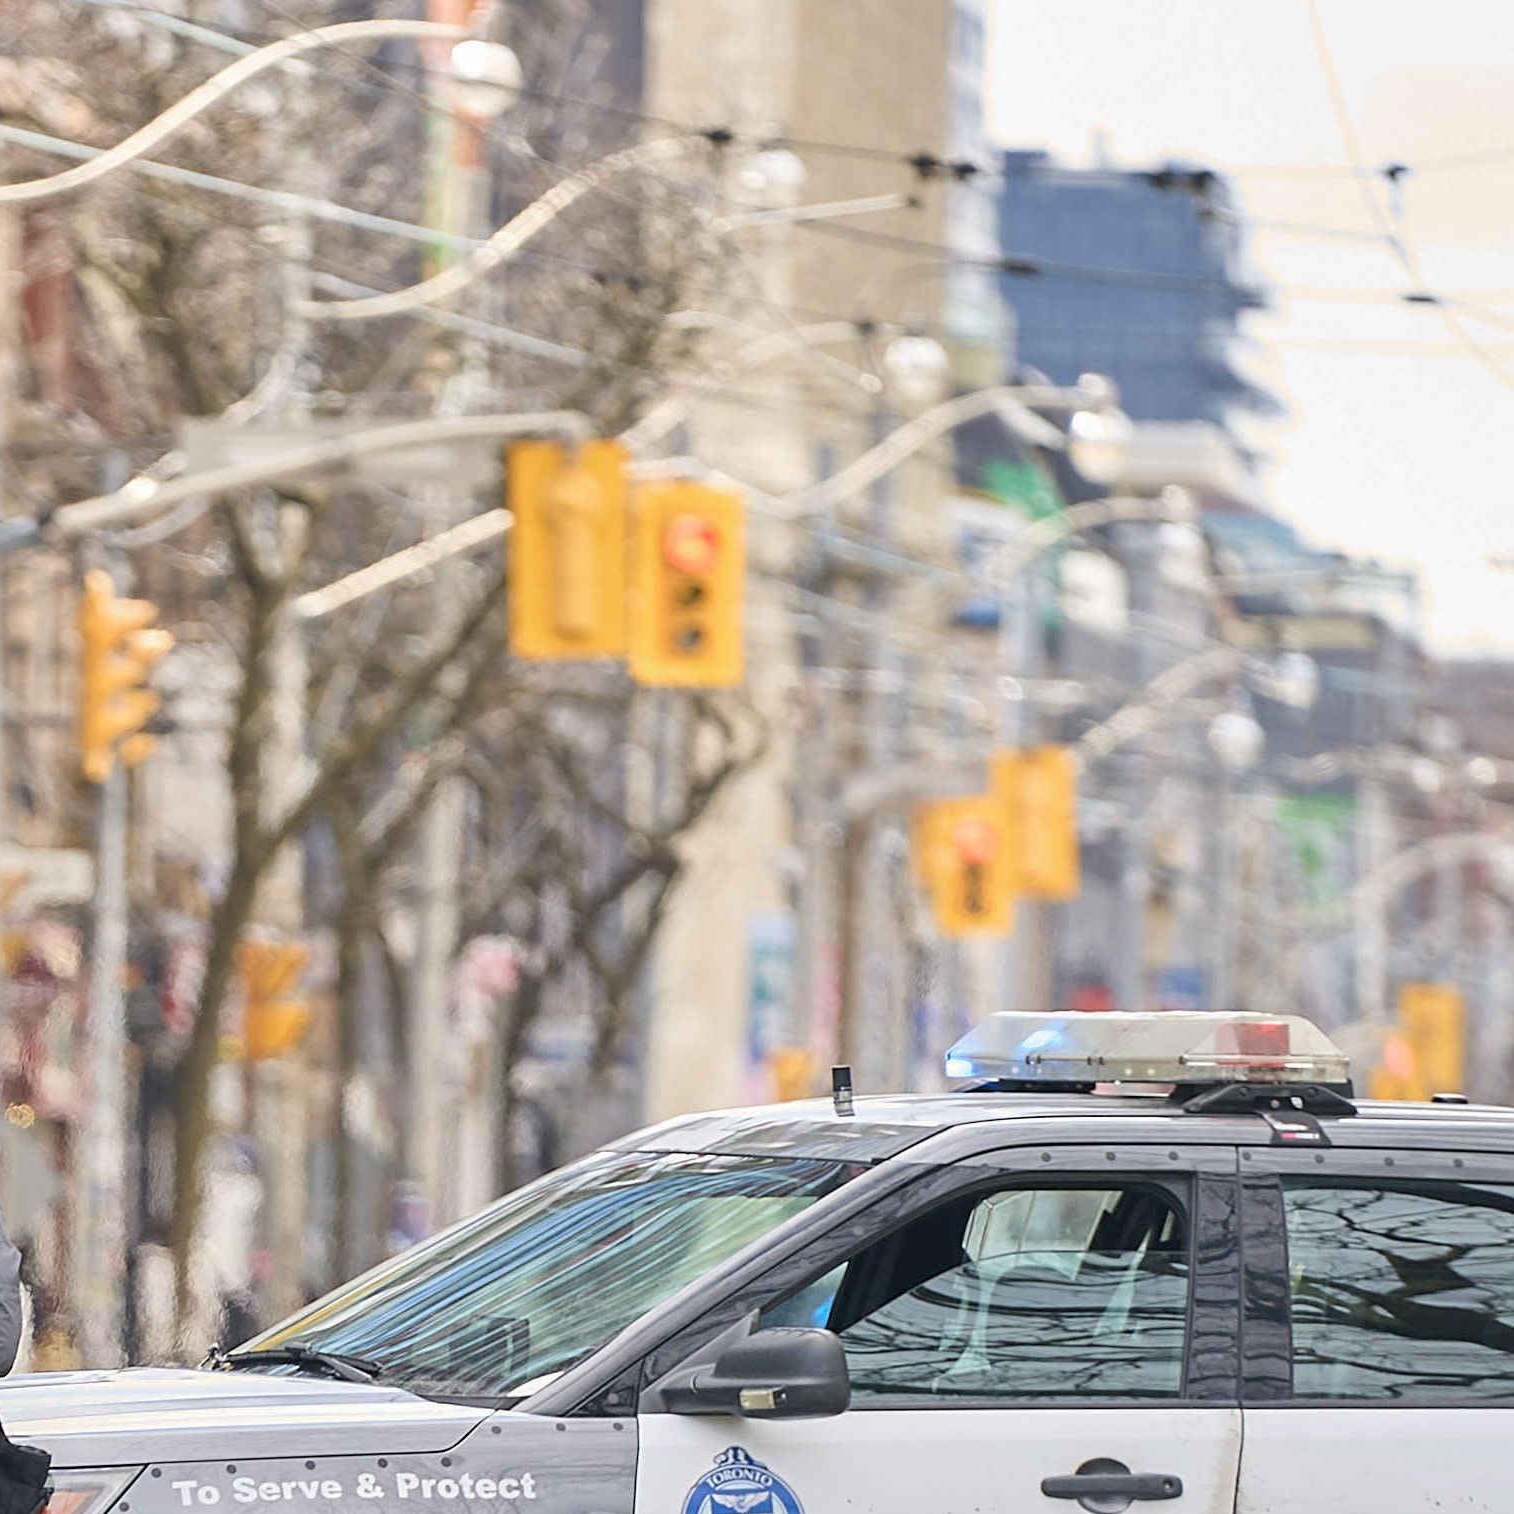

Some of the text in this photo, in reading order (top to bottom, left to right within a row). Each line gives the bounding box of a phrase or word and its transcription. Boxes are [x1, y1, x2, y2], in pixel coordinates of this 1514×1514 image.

[172, 1472, 537, 1506] To Serve & Protect
[706, 1469, 773, 1489] TORONTO
